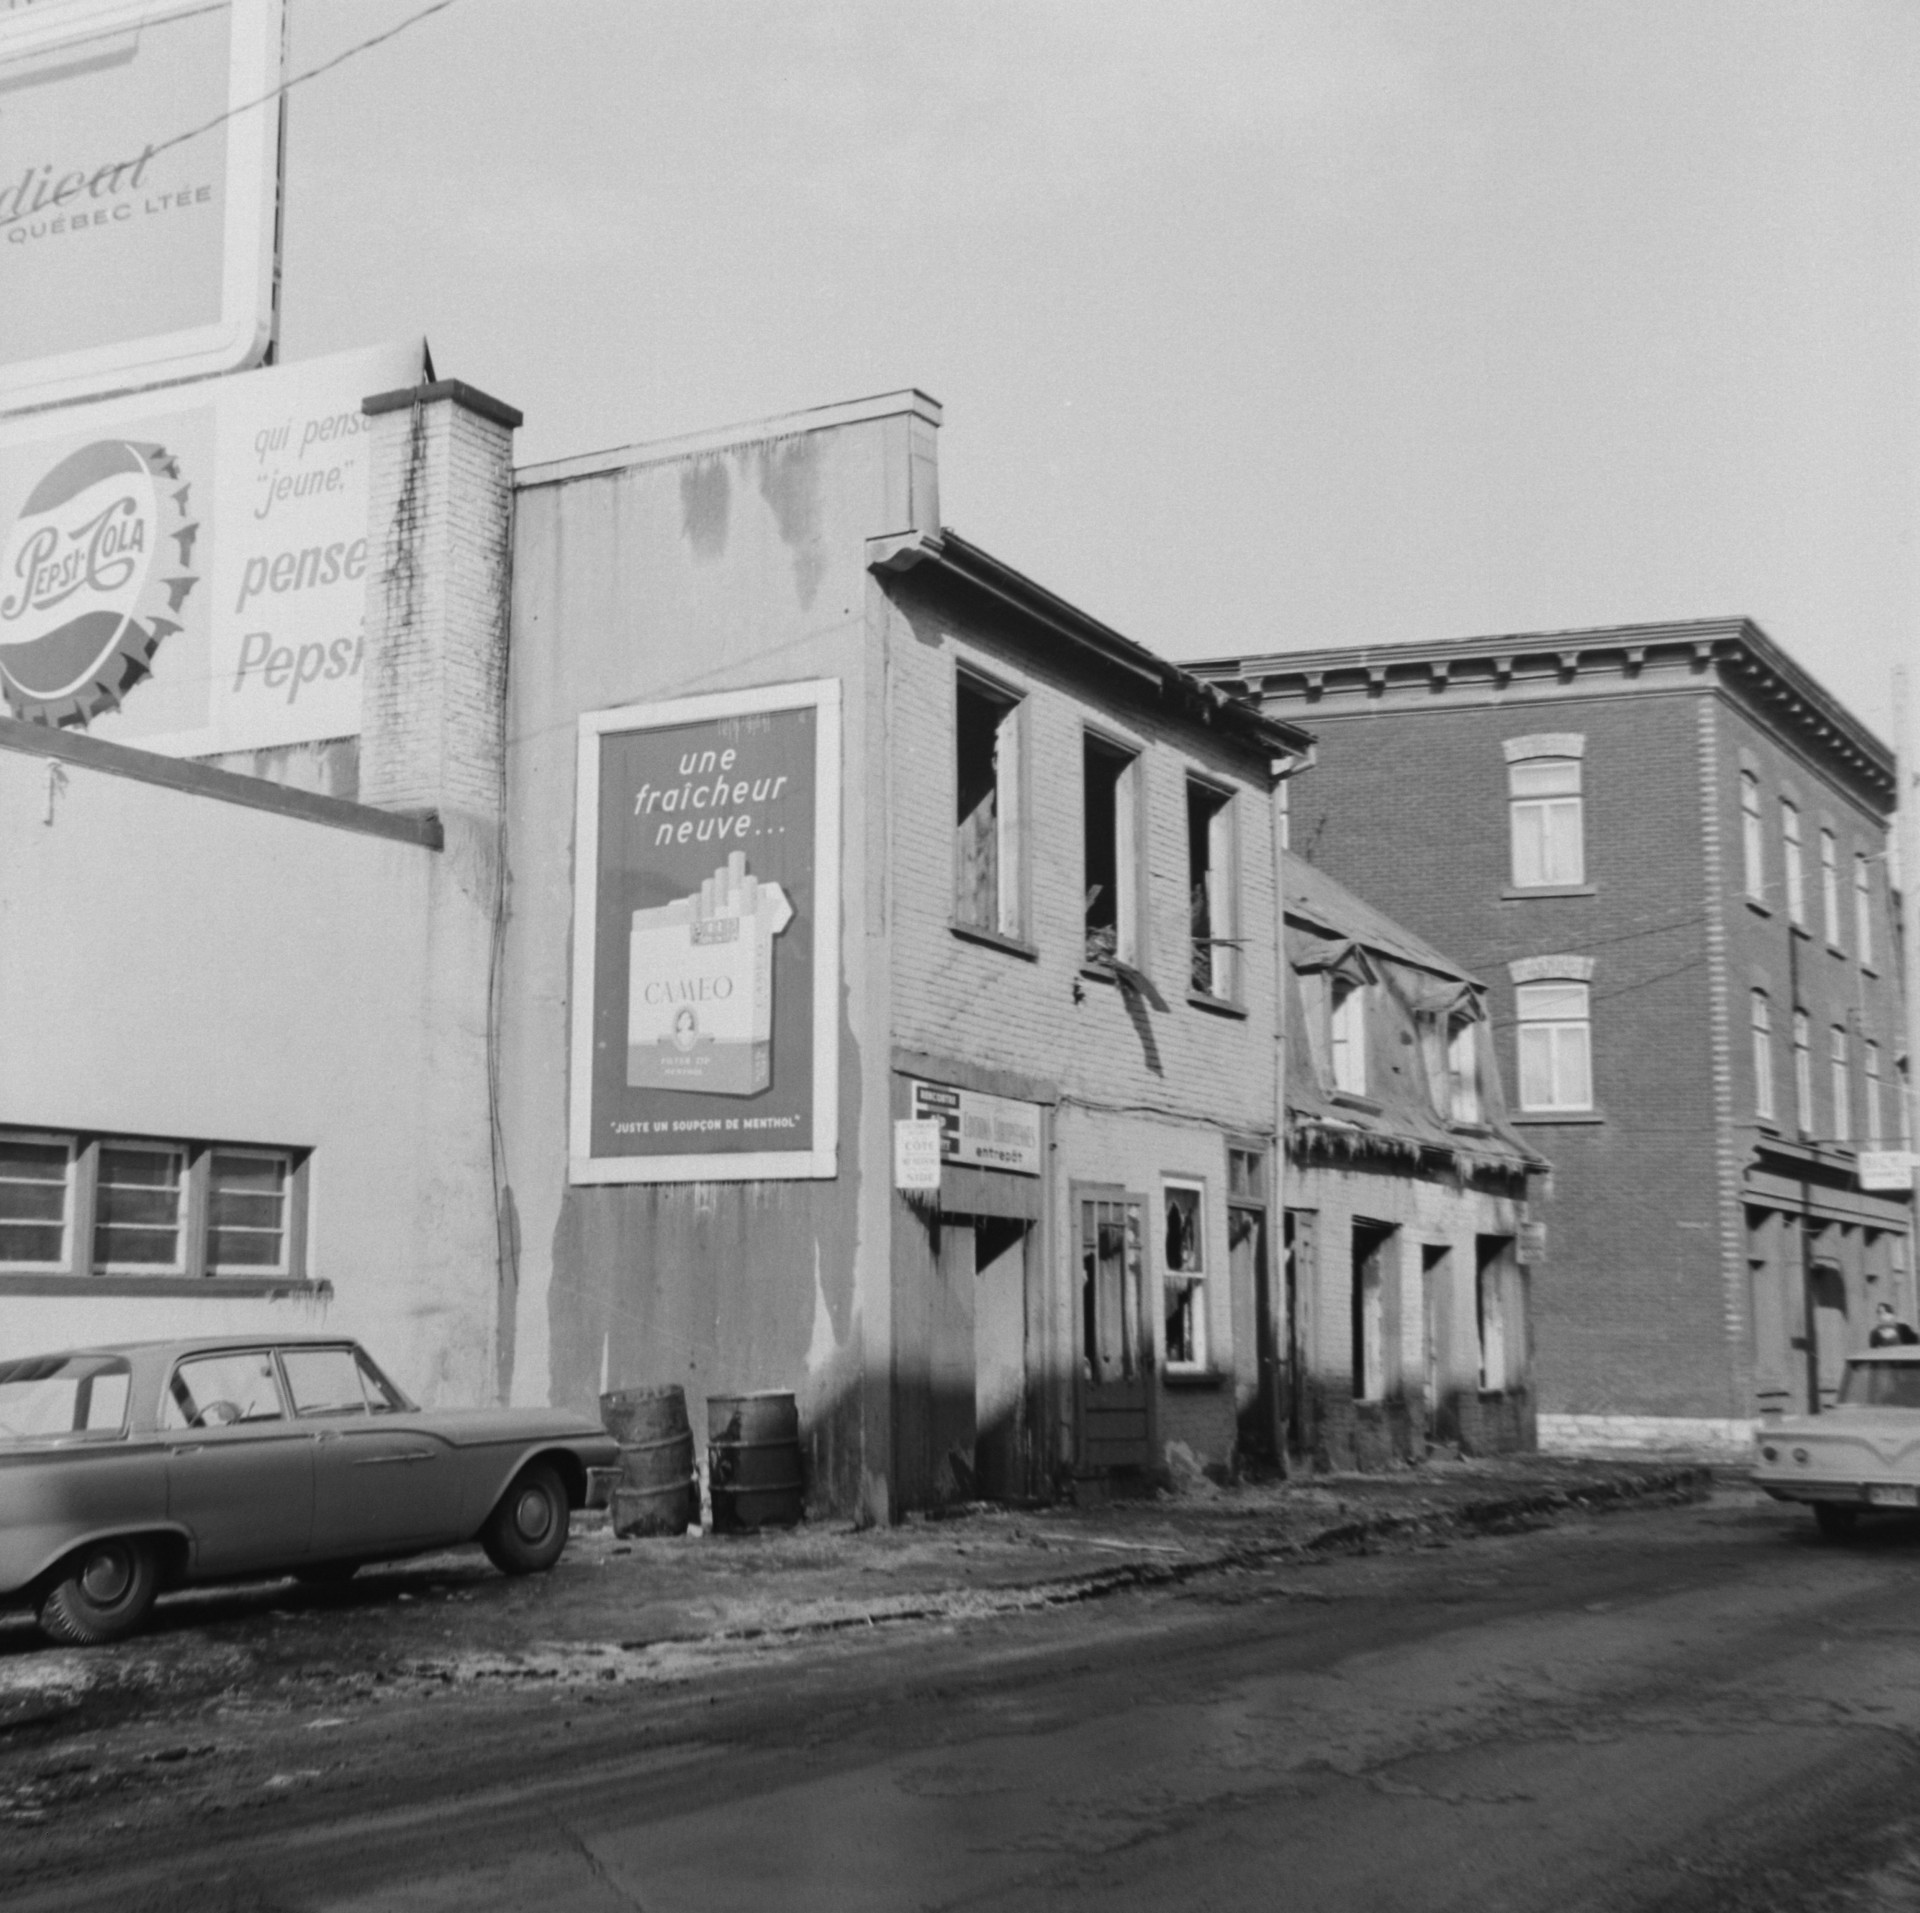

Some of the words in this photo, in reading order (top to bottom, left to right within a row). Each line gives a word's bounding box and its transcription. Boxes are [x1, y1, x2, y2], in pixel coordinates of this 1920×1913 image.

[8, 203, 131, 244] QUÉBEC
[145, 184, 211, 214] LTÉE
[254, 418, 291, 465] qui
[235, 537, 367, 614] pense
[233, 617, 365, 704] Pepsi
[679, 749, 737, 775] une
[634, 775, 787, 815] fraîcheur
[655, 814, 785, 846] neuve...
[644, 976, 733, 1005] CAMEO
[611, 1121, 650, 1134] "JUSTE
[653, 1121, 669, 1132] UN
[672, 1120, 721, 1133] SOUPÇON
[725, 1118, 739, 1130] DE
[743, 1114, 800, 1129] MENTHOL"
